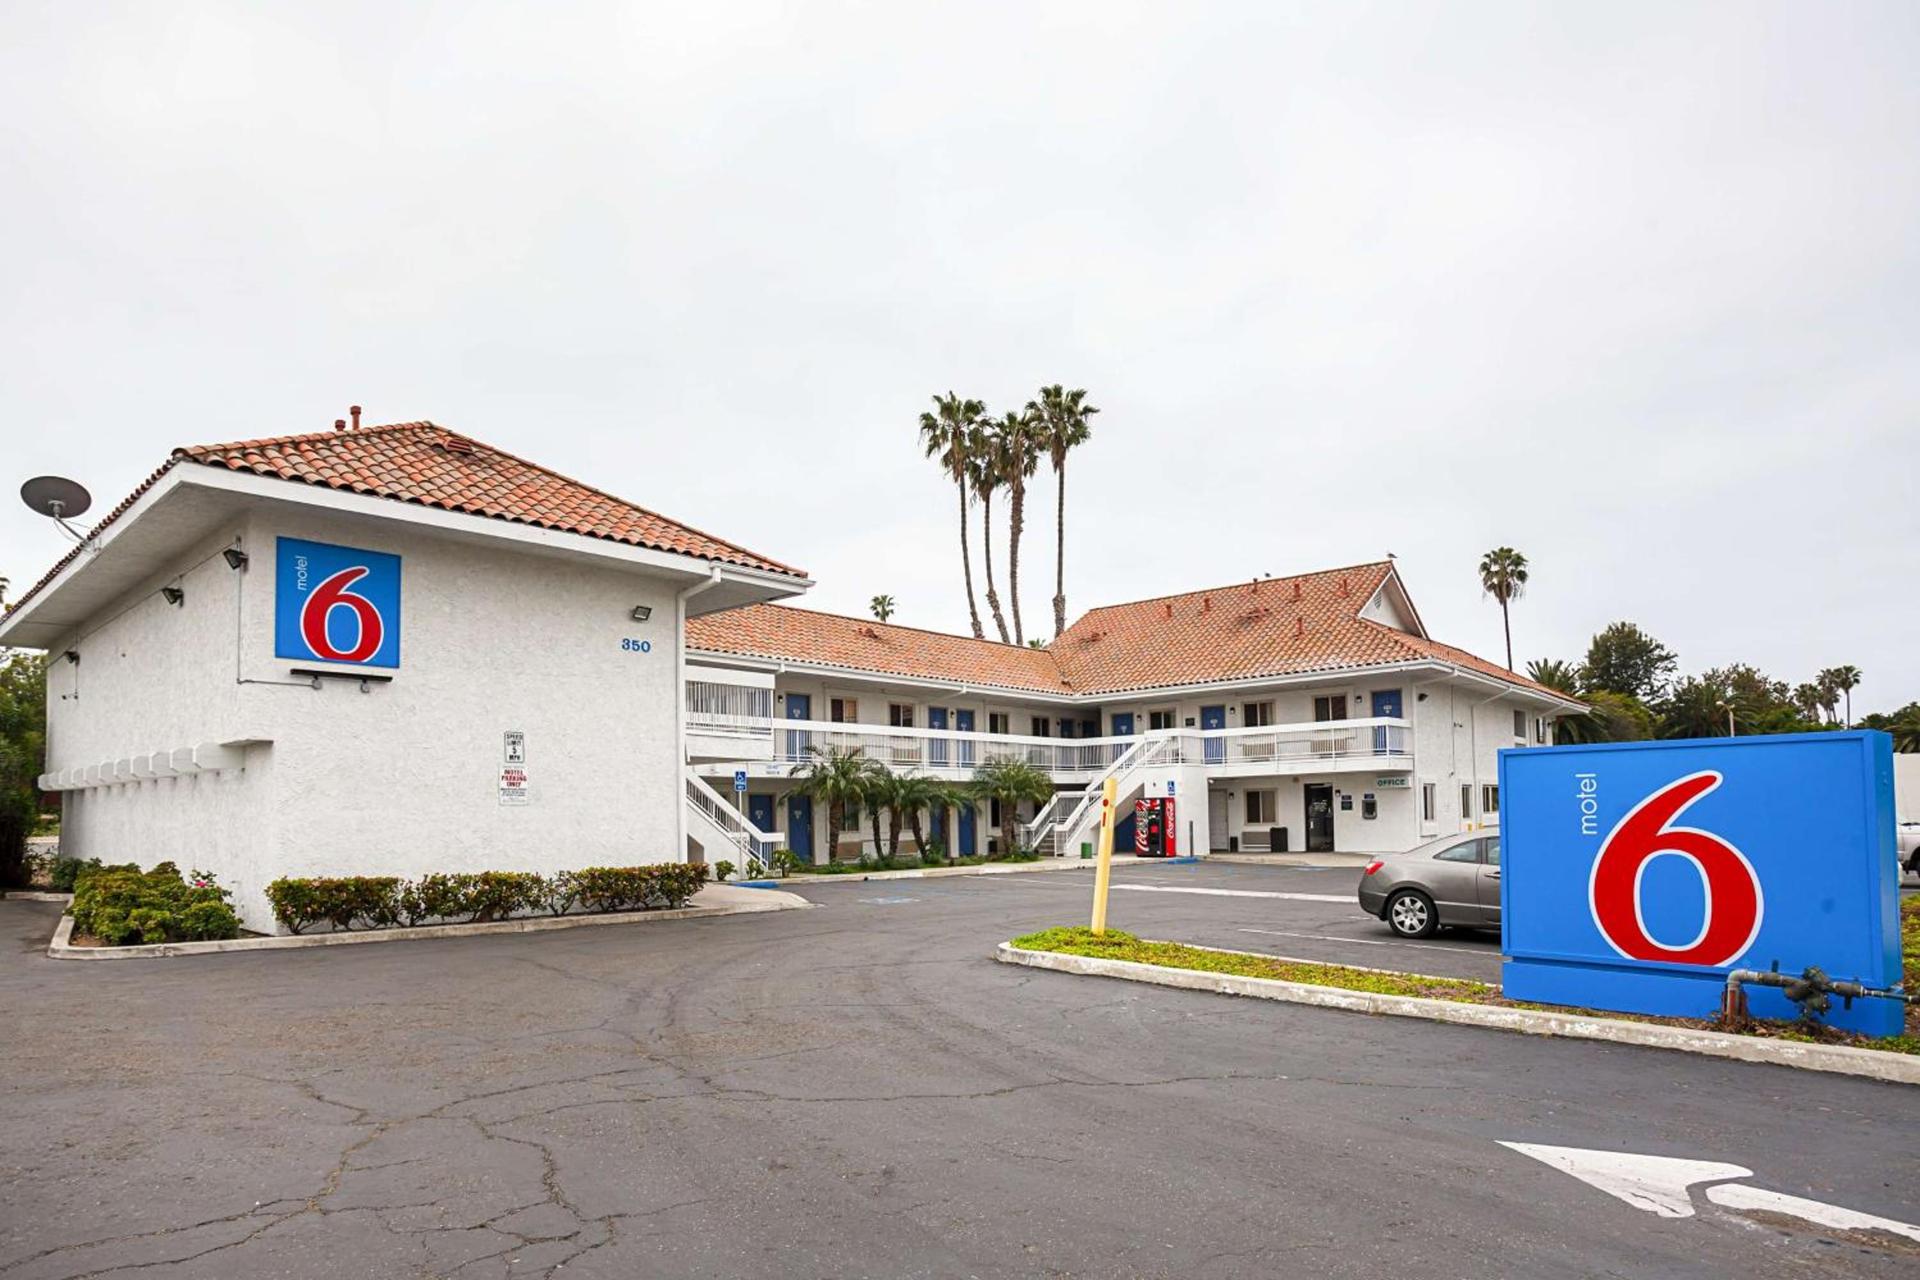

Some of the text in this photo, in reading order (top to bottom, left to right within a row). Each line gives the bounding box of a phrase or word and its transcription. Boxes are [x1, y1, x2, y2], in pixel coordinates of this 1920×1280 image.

[294, 555, 384, 663] motel 6
[621, 637, 651, 653] 350
[1377, 778, 1406, 787] OFFICE
[1575, 769, 1765, 967] motel 6
